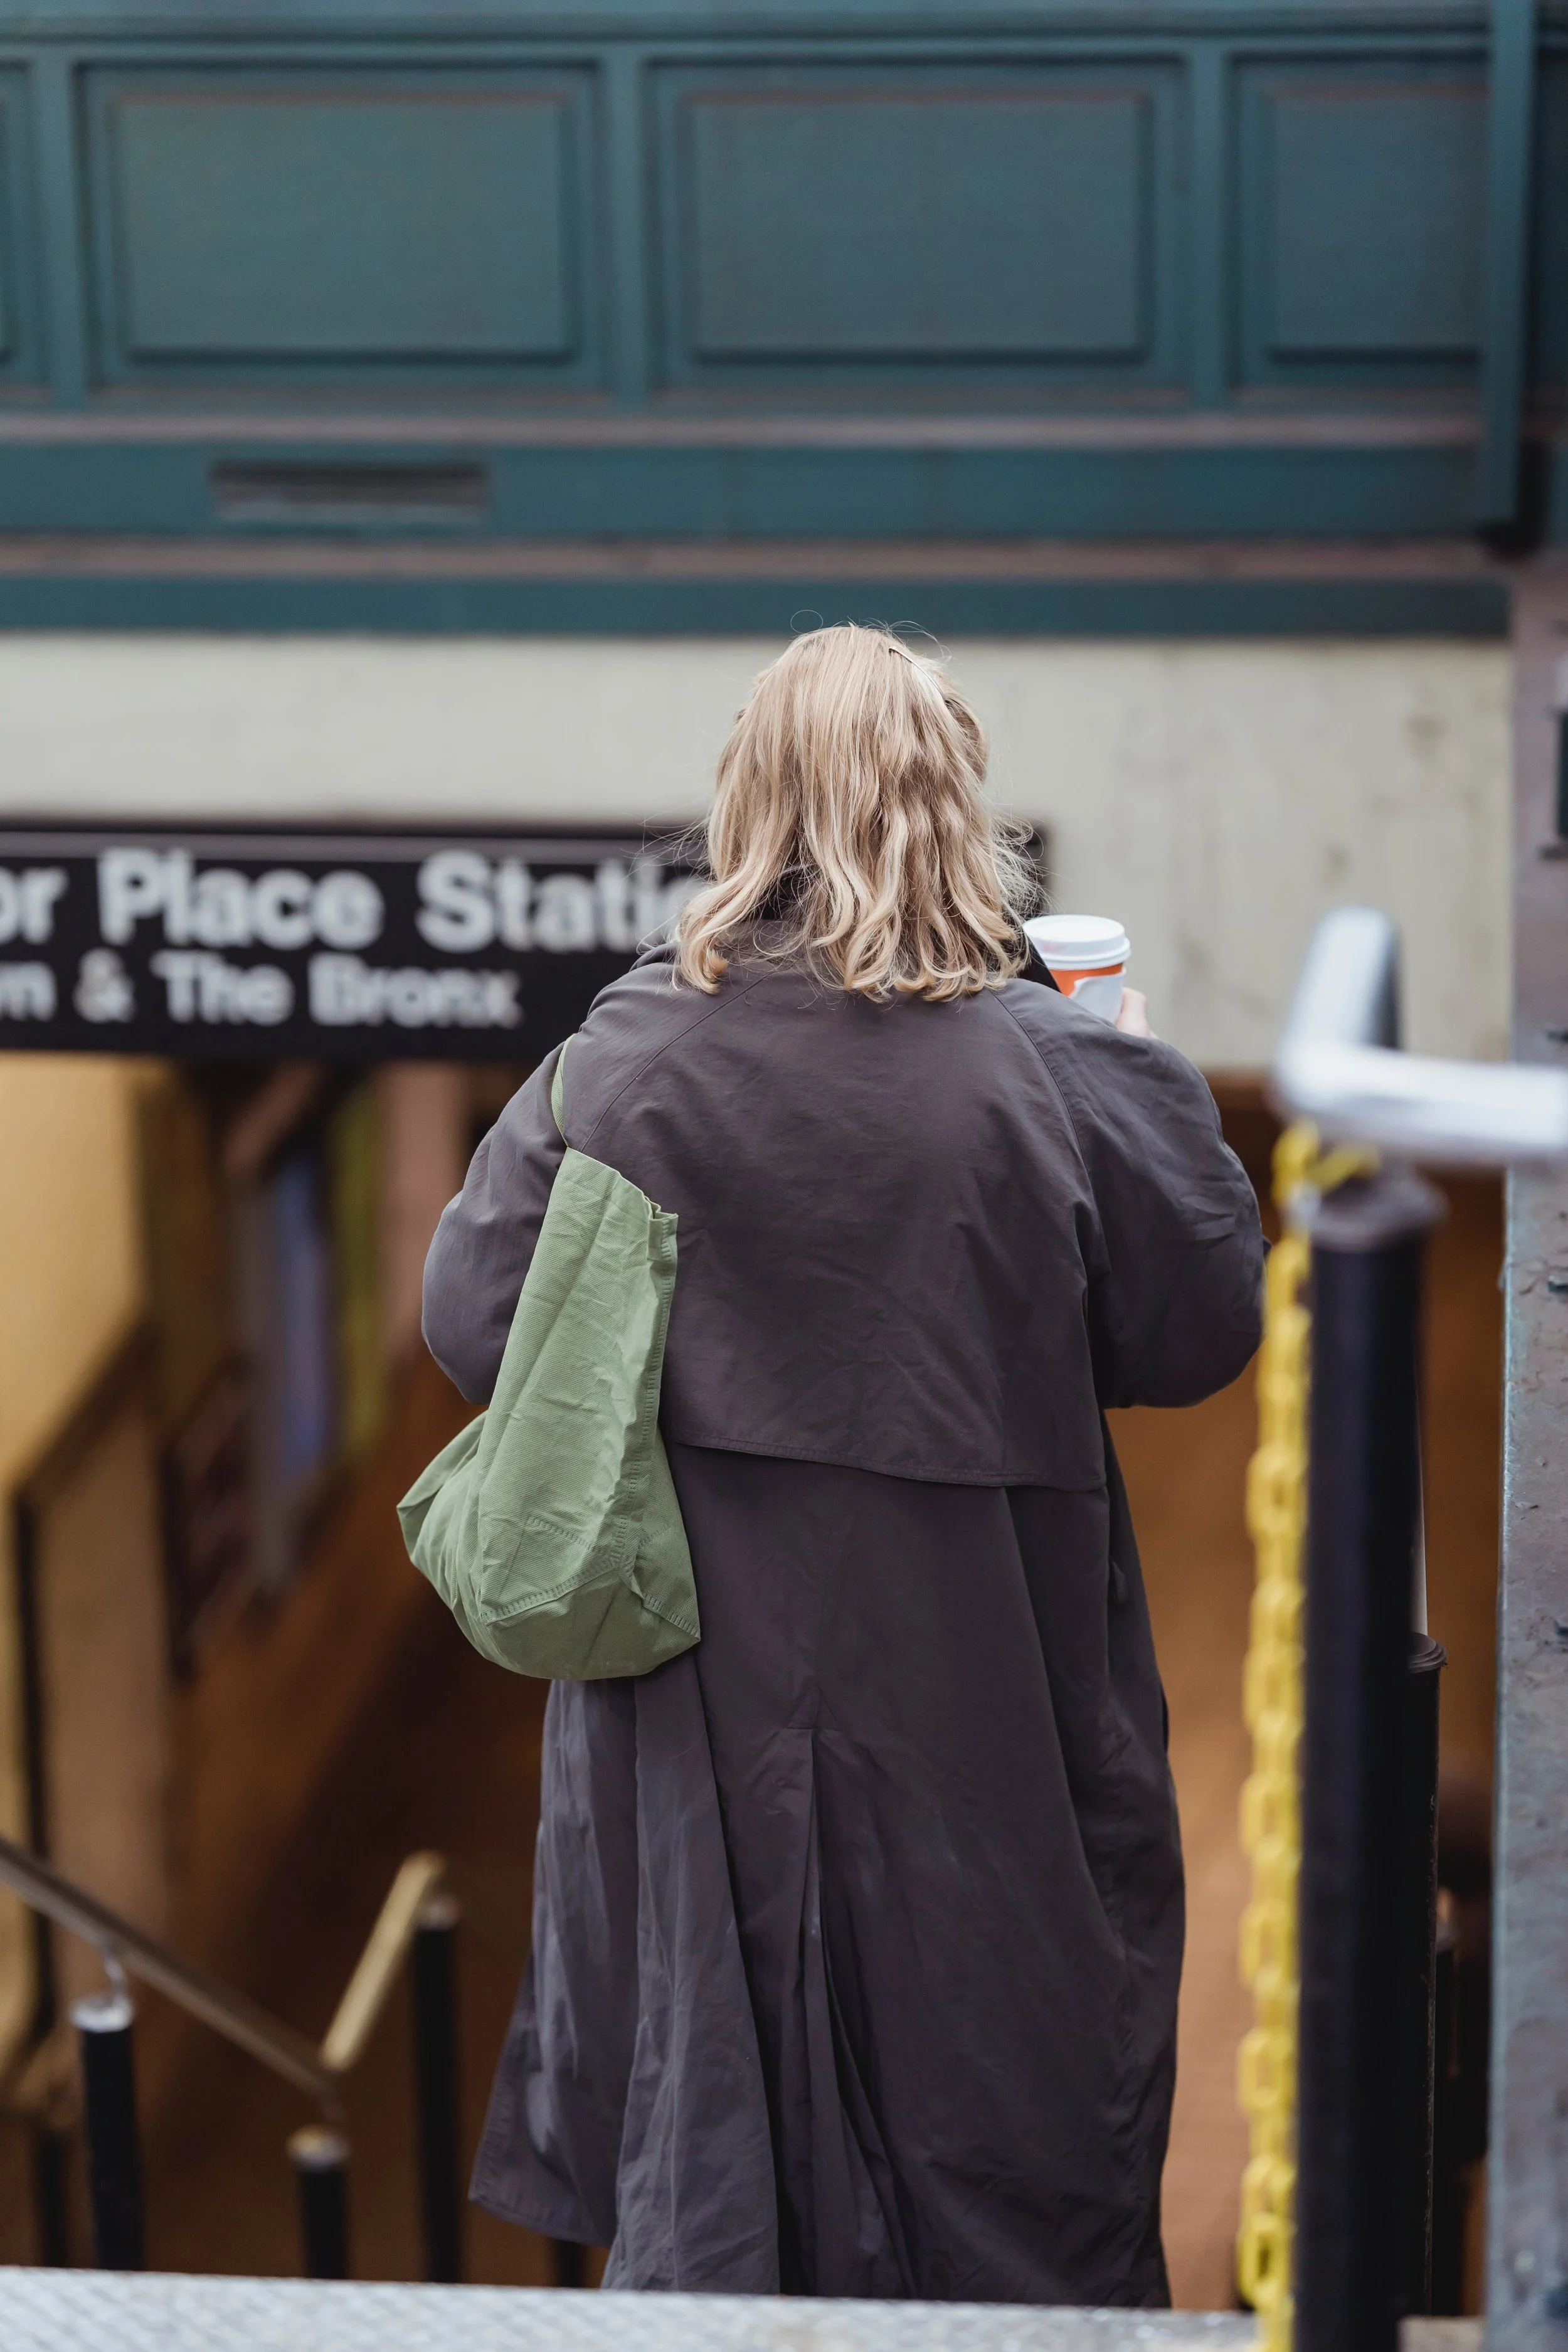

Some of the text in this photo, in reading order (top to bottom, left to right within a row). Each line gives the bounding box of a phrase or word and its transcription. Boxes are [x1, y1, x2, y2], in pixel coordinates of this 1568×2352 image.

[97, 848, 384, 949] Place
[75, 948, 134, 1023] &
[151, 950, 294, 1025] The
[307, 951, 522, 1029] Bronx
